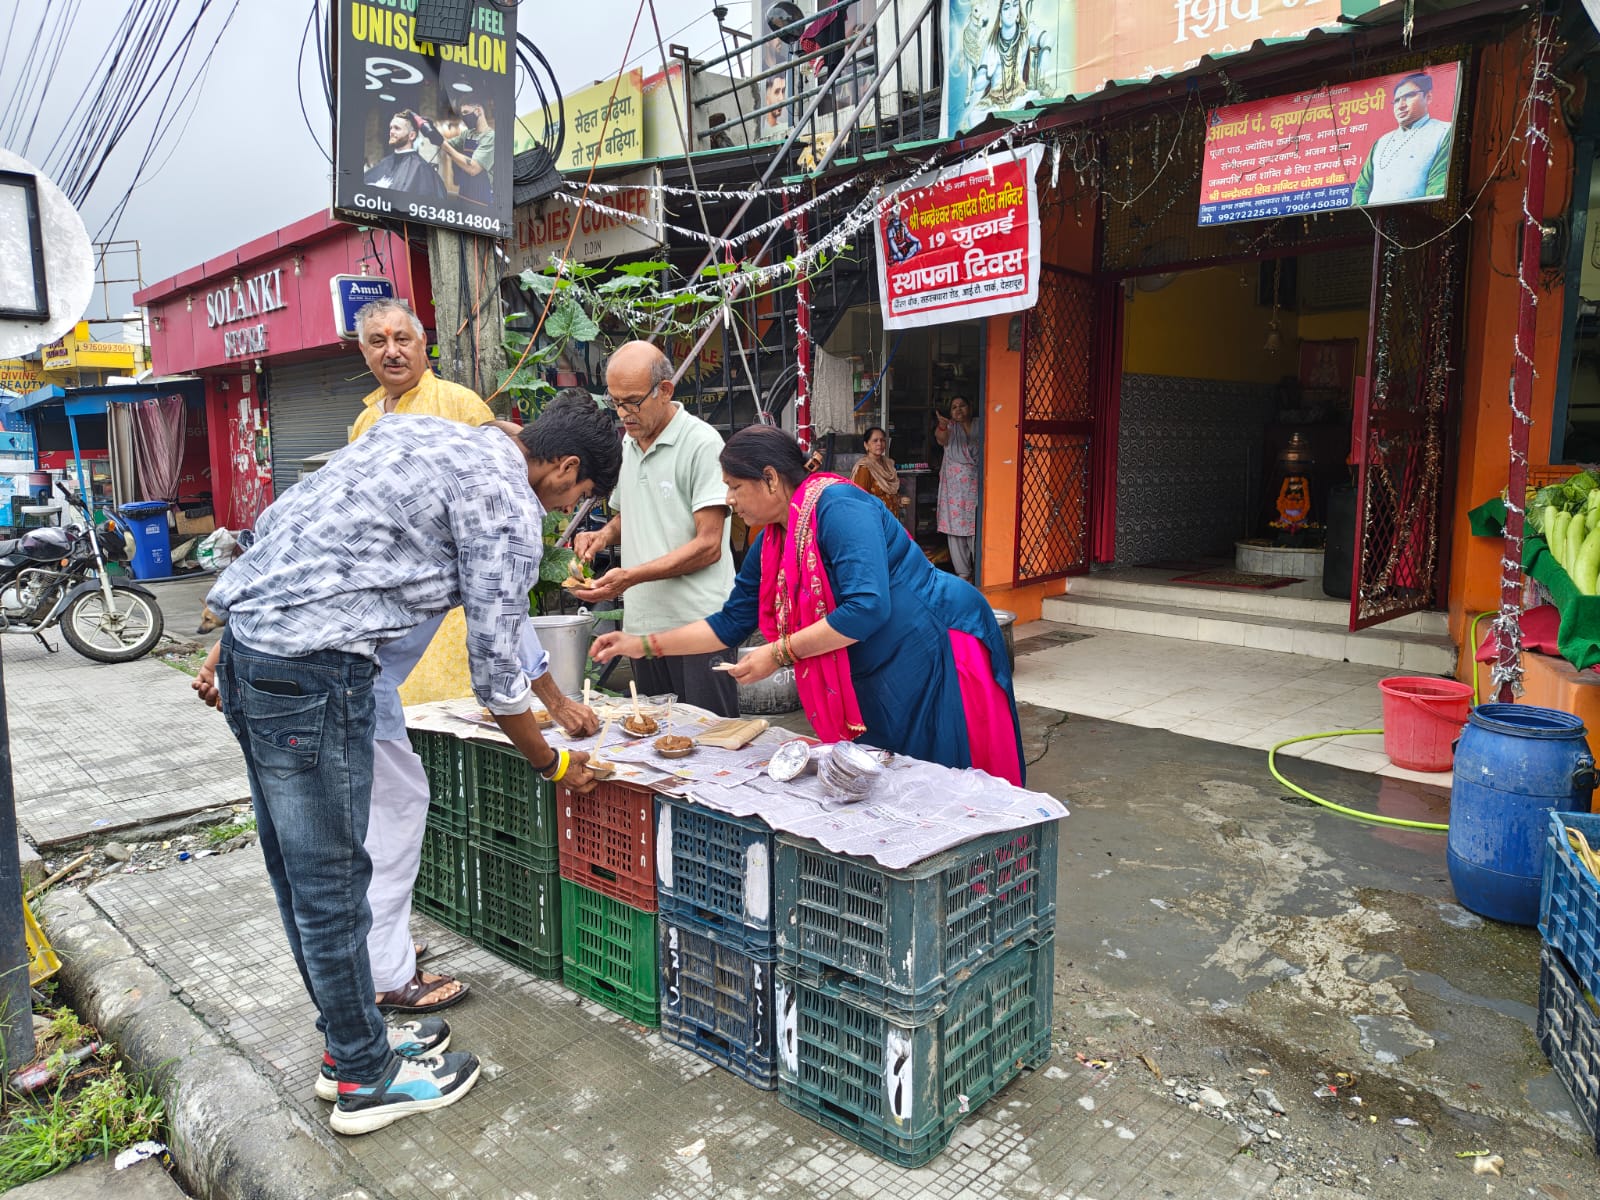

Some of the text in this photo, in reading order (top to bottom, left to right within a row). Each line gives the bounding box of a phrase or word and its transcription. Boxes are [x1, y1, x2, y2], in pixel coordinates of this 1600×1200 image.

[478, 6, 505, 36] FEEL
[574, 109, 599, 134] सेहत
[1209, 112, 1249, 142] आचार्य
[571, 142, 583, 168] तो
[353, 193, 501, 232] Golu 9634814804
[951, 193, 979, 222] महादेव
[979, 187, 996, 215] शिव
[997, 181, 1024, 209] मन्दिर
[1285, 198, 1349, 213] 7906450380
[518, 207, 572, 250] LADIES
[928, 208, 1015, 249] 19 जुलाई
[892, 248, 1024, 294] स्थापना दिवस
[206, 268, 285, 329] SOLANKI
[350, 282, 384, 296] Amul
[0, 380, 45, 390] BEAUTY
[1, 371, 37, 381] DIVINE
